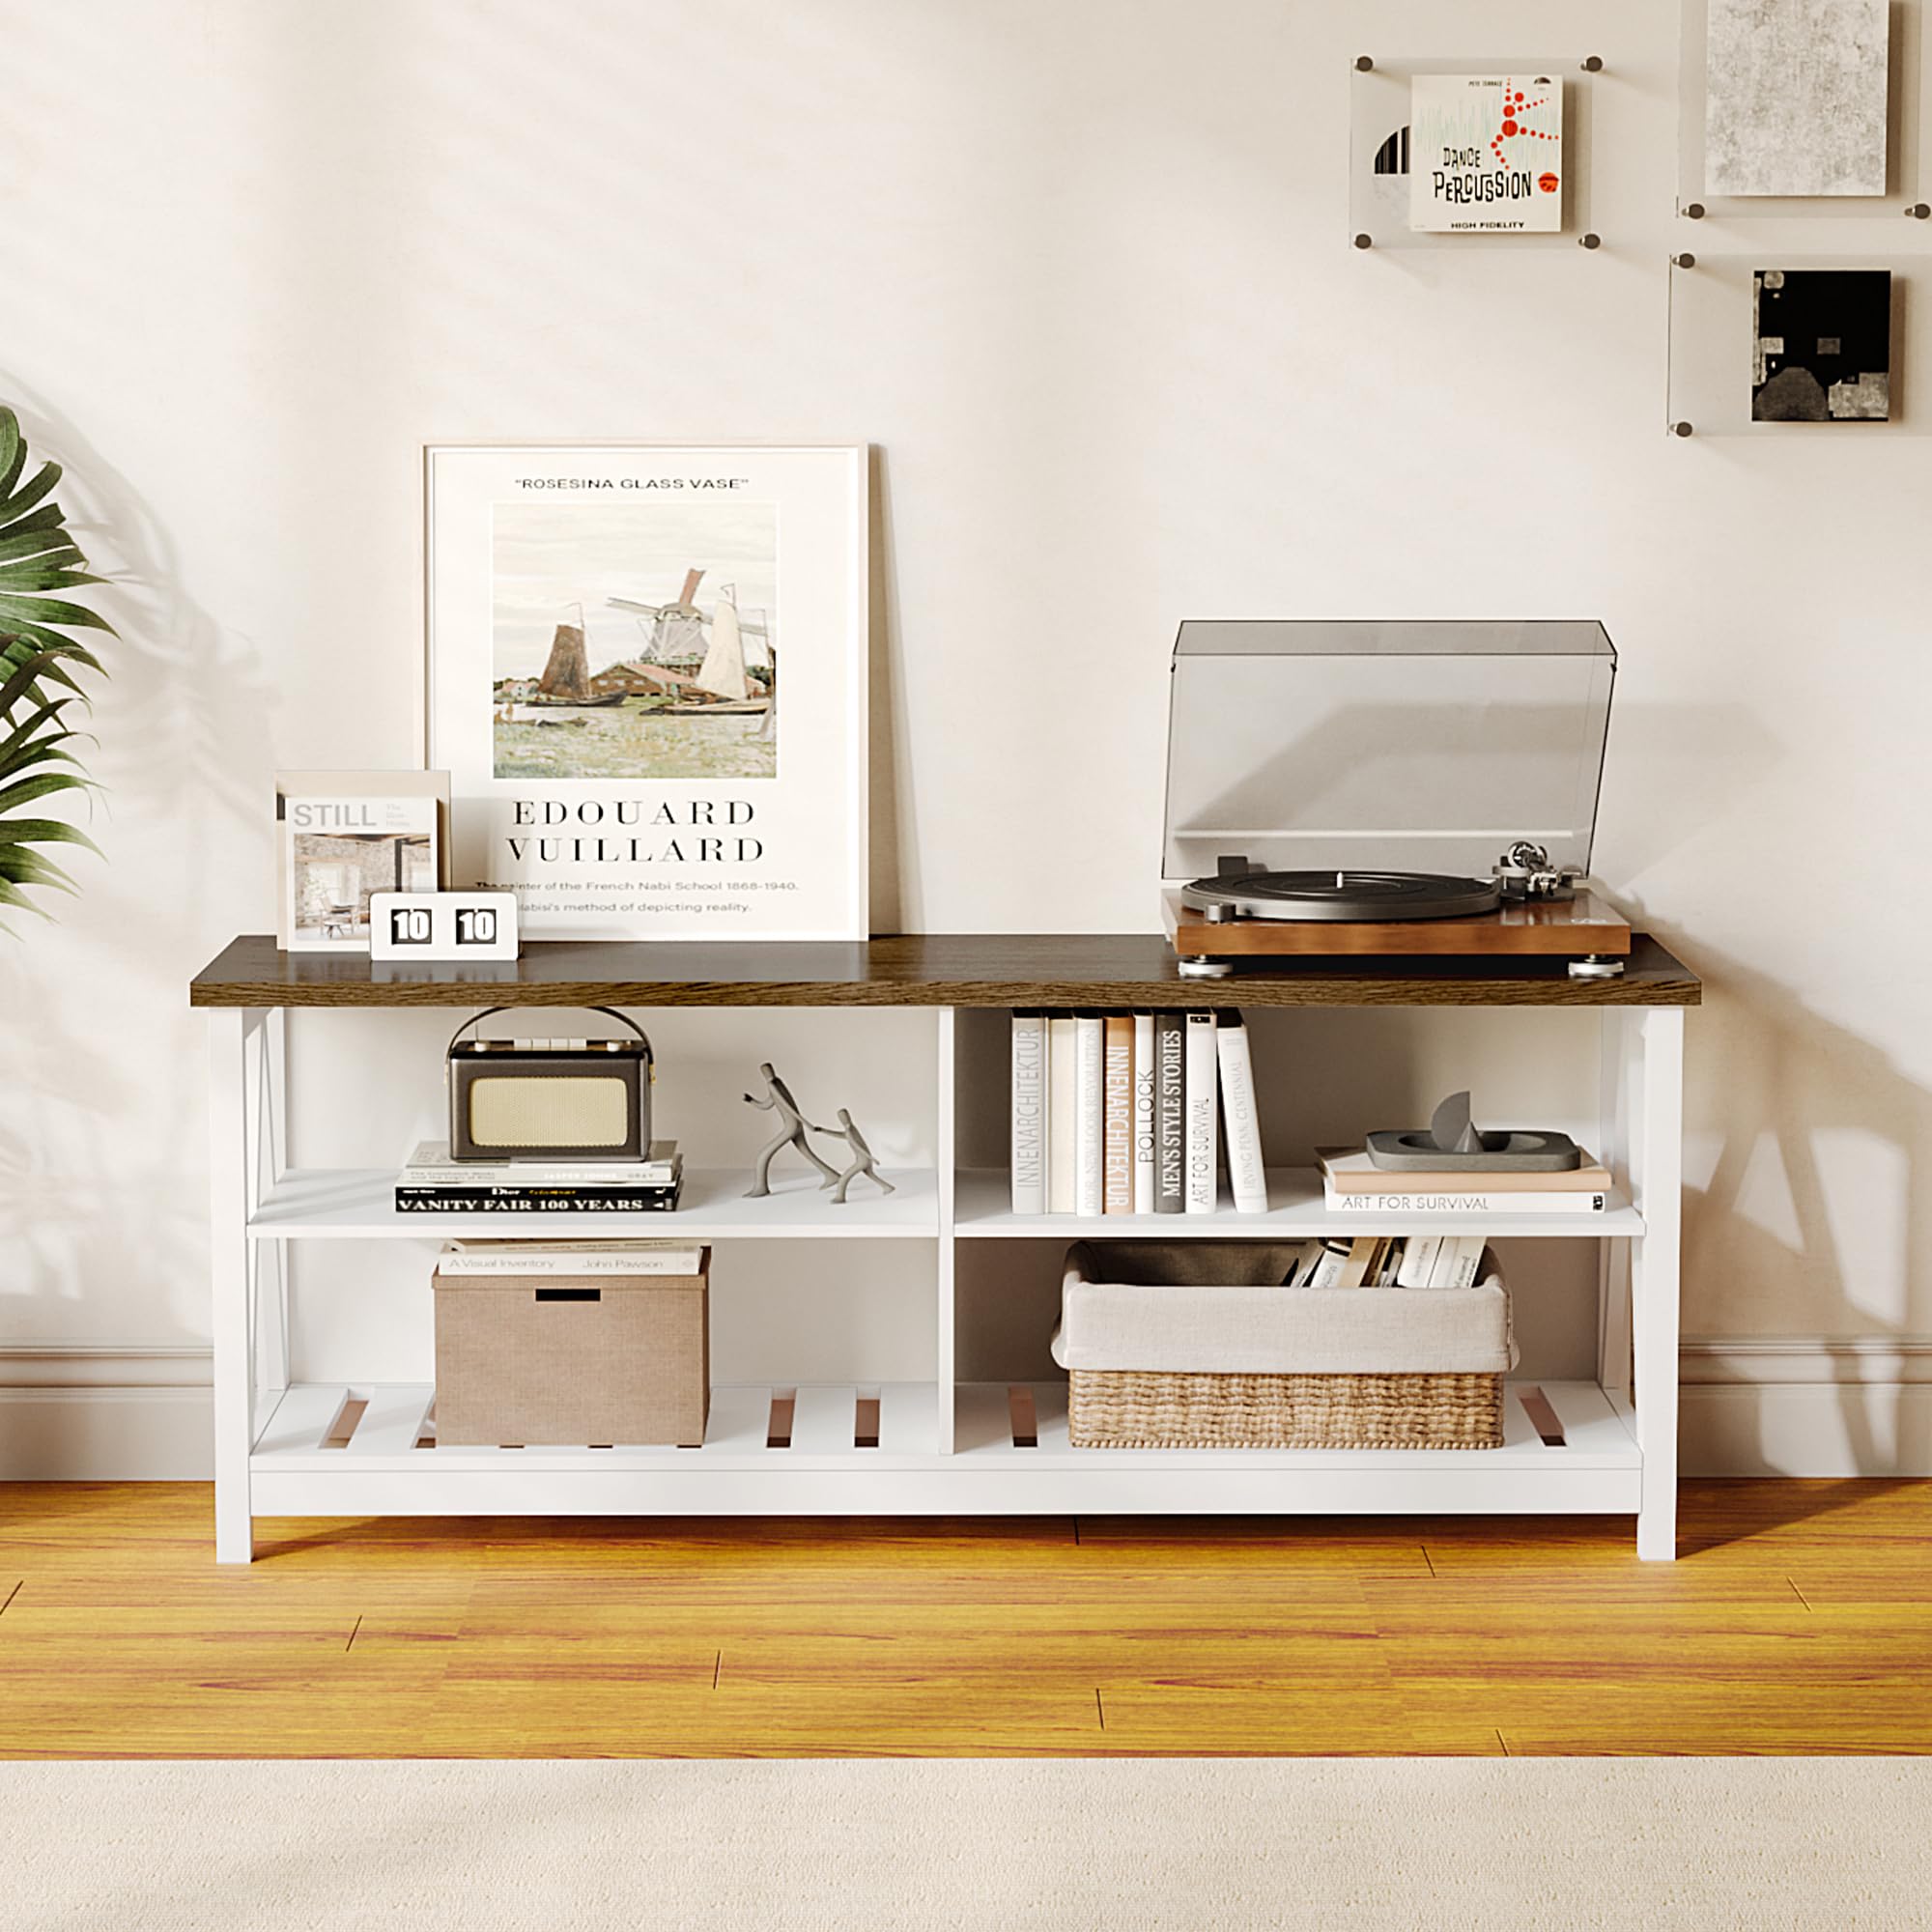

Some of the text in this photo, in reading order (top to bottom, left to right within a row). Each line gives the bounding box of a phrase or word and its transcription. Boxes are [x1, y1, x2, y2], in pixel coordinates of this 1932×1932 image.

[1443, 148, 1481, 170] DANCE
[1433, 171, 1532, 204] PERCUSSION
[620, 479, 684, 489] GLASS
[294, 804, 377, 827] STILL
[513, 800, 756, 826] EDOUARD
[506, 838, 765, 863] VUILLARD
[545, 881, 556, 890] of
[559, 881, 582, 890] the
[586, 881, 634, 891] French
[639, 881, 671, 891] Nabi
[676, 881, 723, 891] School
[726, 881, 800, 891] 1868-1940.
[563, 903, 615, 912] method
[620, 903, 634, 912] of
[638, 902, 703, 913] depicting
[706, 902, 753, 913] reality.
[393, 910, 496, 941] 10 10
[1016, 1028, 1039, 1188] INNENARCHITEKTUR
[1138, 1070, 1154, 1163] POLLOCK
[1162, 1030, 1181, 1197] MEN'S STYLE STORIES
[1106, 1045, 1129, 1207] INNENARCHITEKTUR
[1191, 1097, 1209, 1206] ART FOR SURVIVAL
[398, 1200, 643, 1209] VANITY FAIR 100 YEARS
[1342, 1196, 1489, 1209] ART FOR SURVIVAL
[449, 1259, 664, 1269] A Visual Inventory John Pawson
